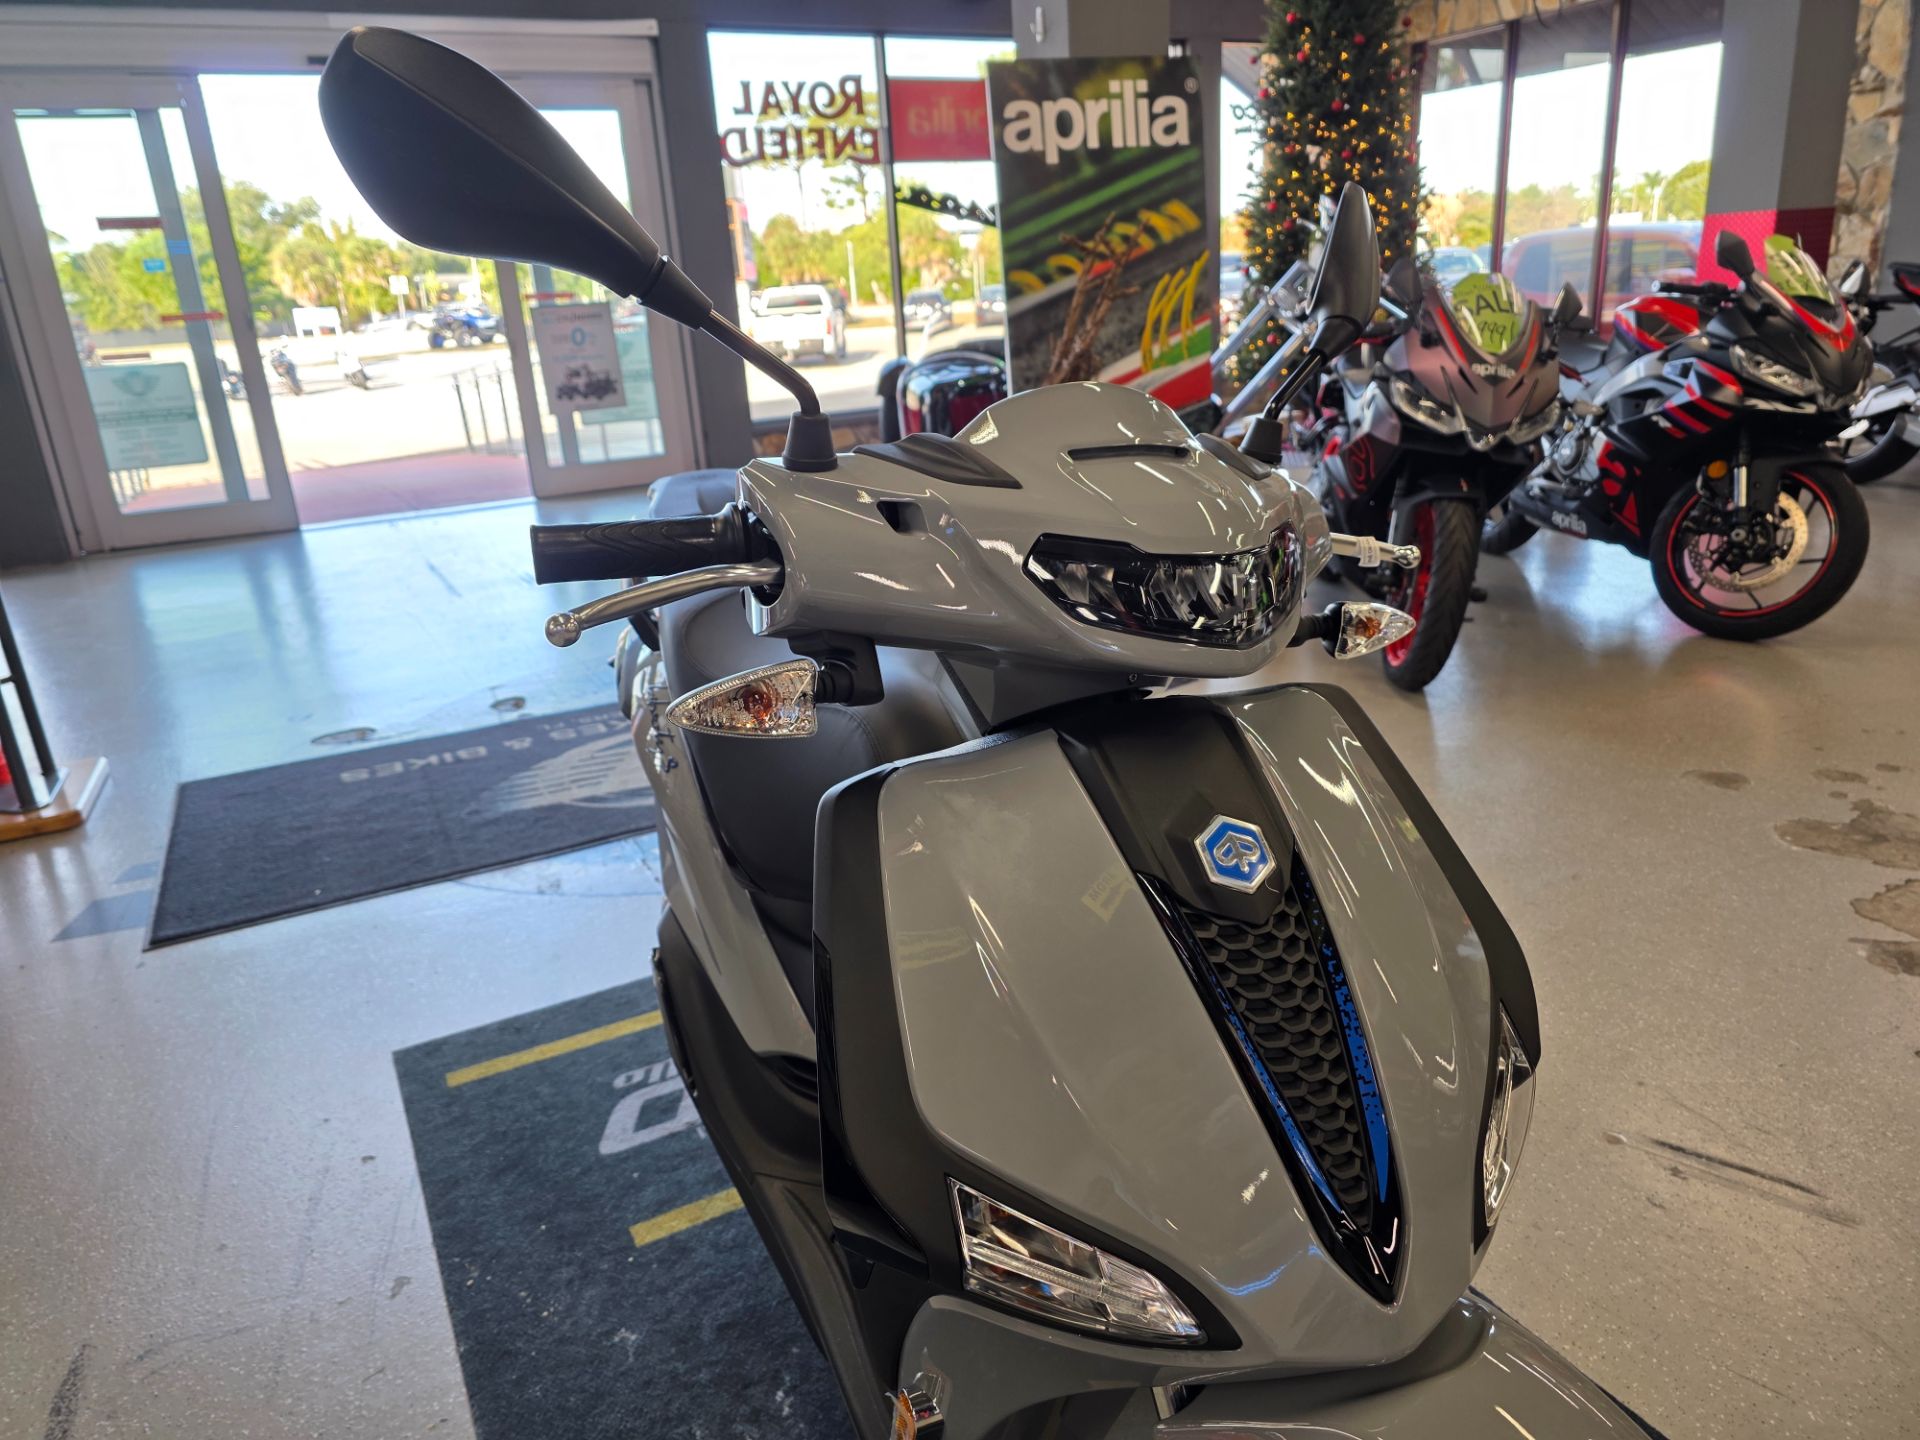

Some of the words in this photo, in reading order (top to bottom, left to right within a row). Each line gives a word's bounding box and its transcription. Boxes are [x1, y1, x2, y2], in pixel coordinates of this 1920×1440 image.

[1002, 79, 1190, 165] aprilia
[1471, 362, 1517, 379] aprilia
[1551, 510, 1588, 536] aprilia
[340, 745, 488, 783] BIKES
